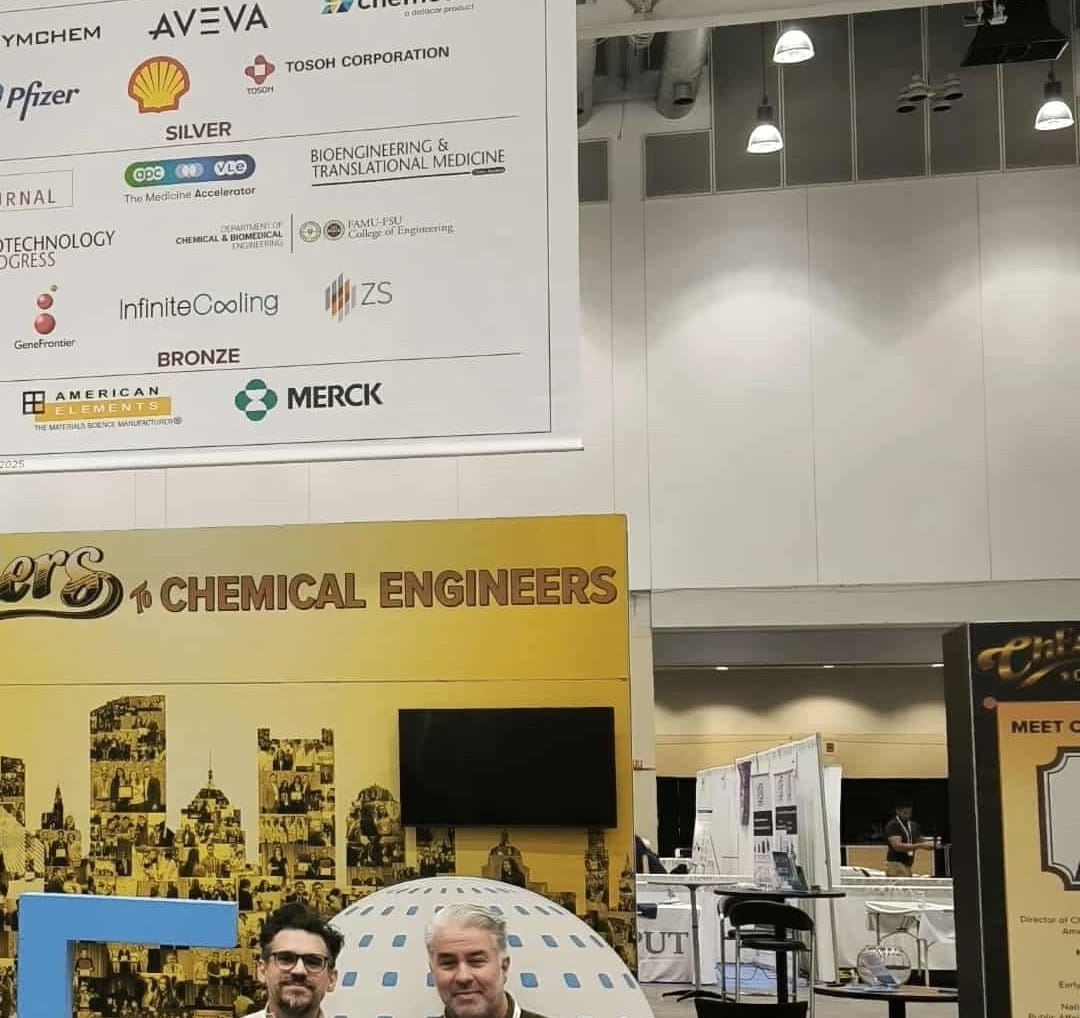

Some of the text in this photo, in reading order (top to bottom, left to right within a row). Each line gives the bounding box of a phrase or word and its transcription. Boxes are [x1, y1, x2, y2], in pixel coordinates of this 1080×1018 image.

[148, 3, 269, 40] AVEVA
[284, 46, 450, 73] TOSOH CORPORATION
[6, 80, 80, 121] Pfizer
[247, 86, 274, 95] TOSOH
[165, 121, 232, 141] SILVER
[311, 137, 449, 163] BIOENGINEERING &
[312, 149, 505, 178] TRANSLATIONAL MEDICINE
[125, 187, 257, 203] The Medicine Accelerator
[176, 235, 220, 244] CHEMICAL
[230, 230, 284, 241] BIOMEDICAL
[348, 223, 454, 239] College of Engineering
[360, 281, 393, 306] ZS
[14, 338, 77, 350] GeneFrontier
[157, 348, 240, 368] BRONZE
[56, 386, 160, 401] AMERICAN
[287, 382, 384, 410] MERCK
[55, 401, 159, 416] ELEMENTS
[0, 460, 25, 469] 2025
[159, 572, 367, 613] CHEMICAL
[378, 566, 618, 609] ENGINEERS
[1011, 720, 1064, 733] MEET
[638, 931, 689, 954] UT
